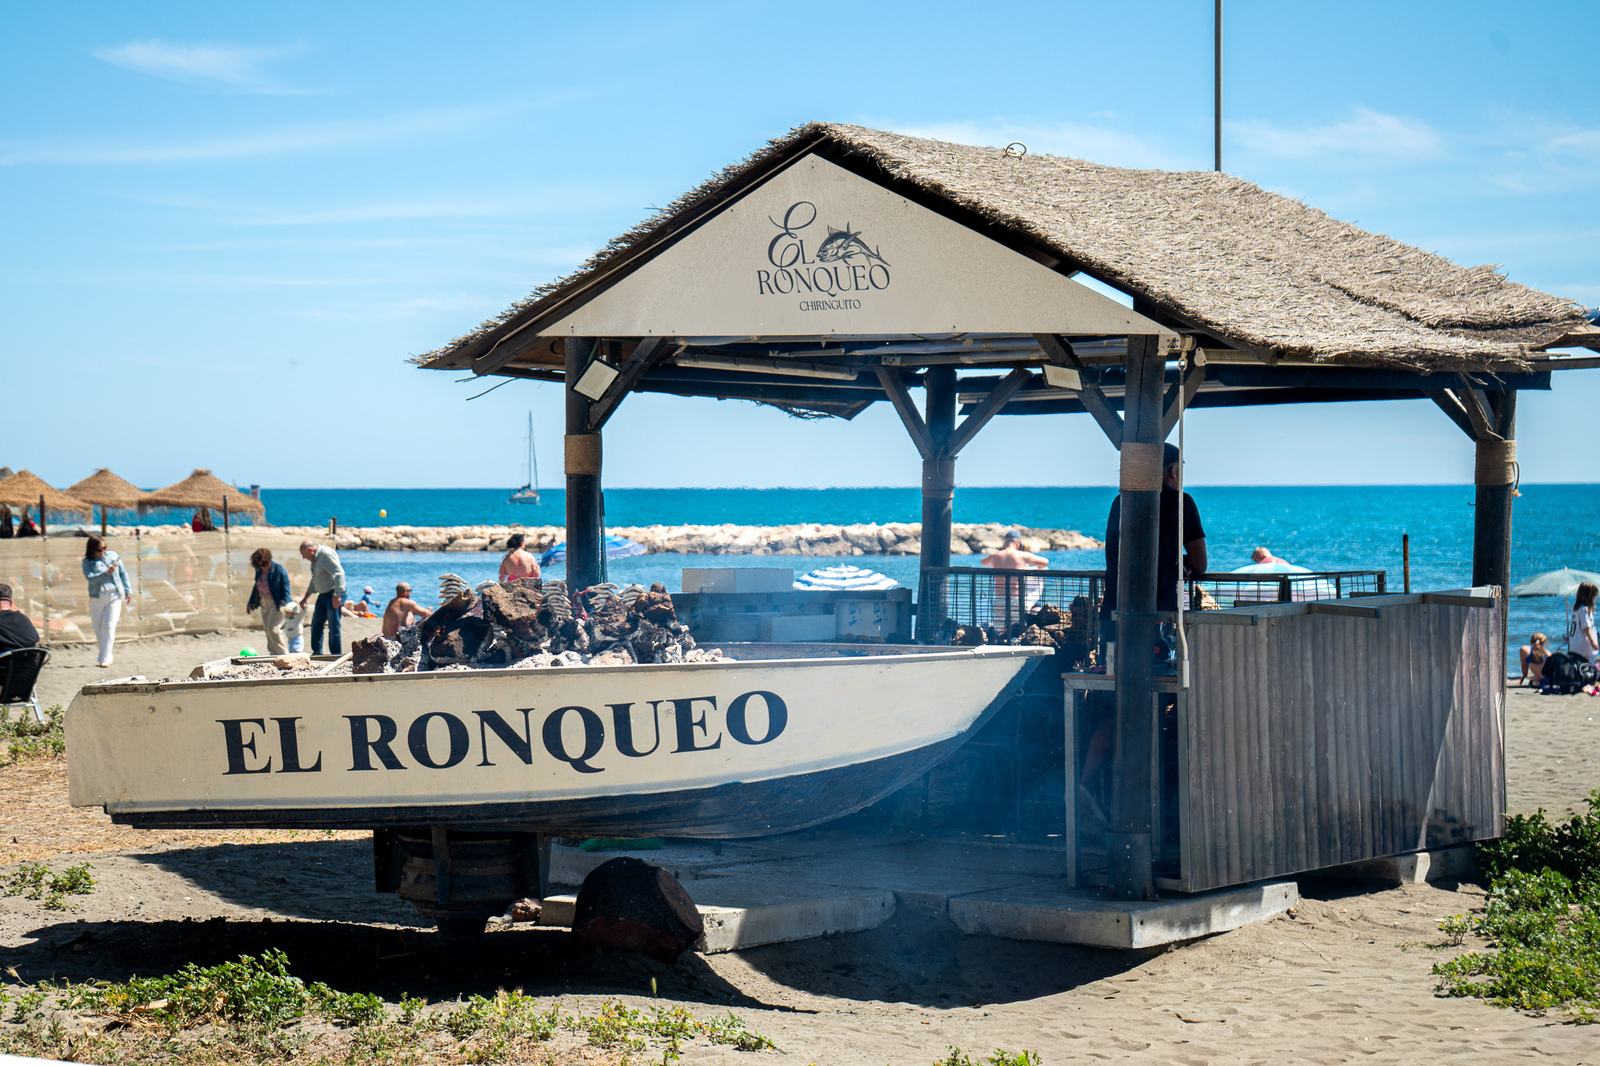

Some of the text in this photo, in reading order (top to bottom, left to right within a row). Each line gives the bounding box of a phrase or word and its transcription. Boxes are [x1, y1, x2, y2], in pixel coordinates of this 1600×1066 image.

[757, 264, 890, 297] RONQUEO
[800, 299, 861, 311] CHIRINGUITO
[215, 690, 788, 775] EL RONQUEO
